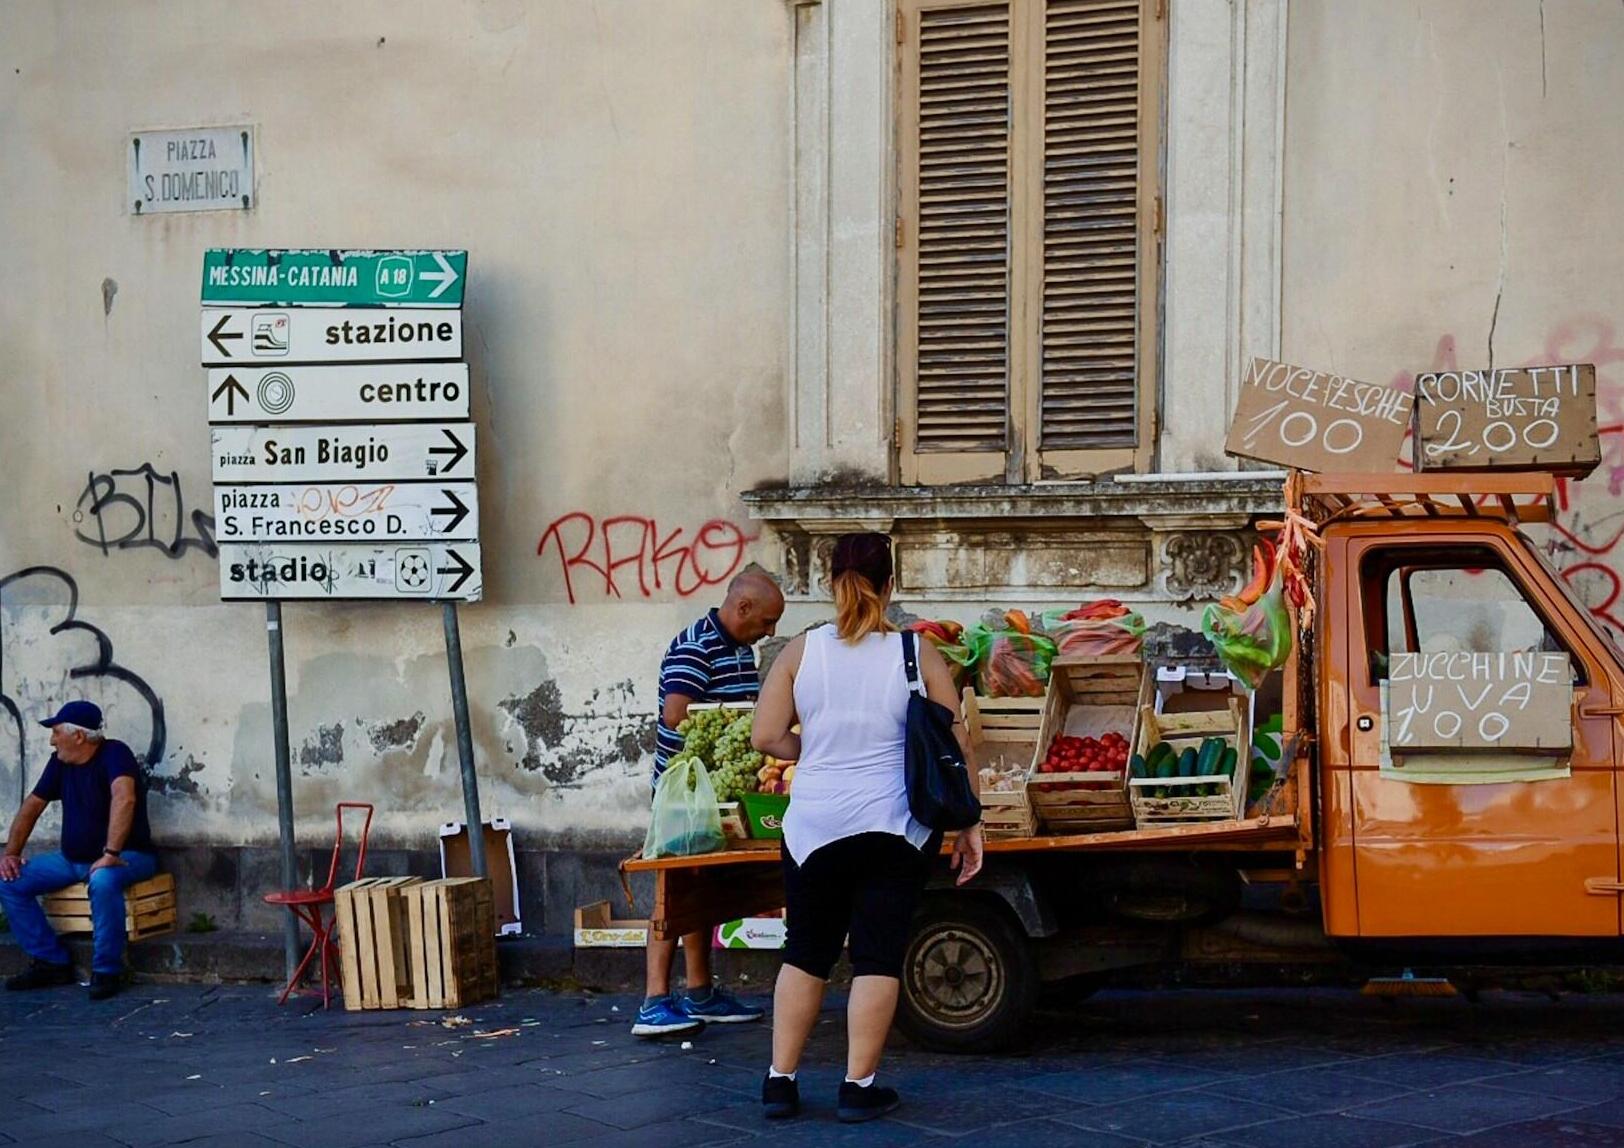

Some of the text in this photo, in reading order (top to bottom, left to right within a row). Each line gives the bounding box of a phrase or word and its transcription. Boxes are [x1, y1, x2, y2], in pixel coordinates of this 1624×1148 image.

[167, 139, 217, 161] PIAZZA
[209, 265, 358, 288] MESSINA-CATANIA
[325, 316, 454, 345] stazione
[360, 378, 460, 403] centro
[1487, 396, 1560, 420] BUSTA
[1425, 410, 1560, 456] 2,00
[220, 437, 389, 469] piazza San Biagio
[222, 488, 280, 513] piazza
[224, 514, 407, 536] S. Francesco D.
[229, 556, 330, 583] stadio
[1389, 651, 1565, 684] ZUCCHINE
[1396, 706, 1511, 744] 1,00
